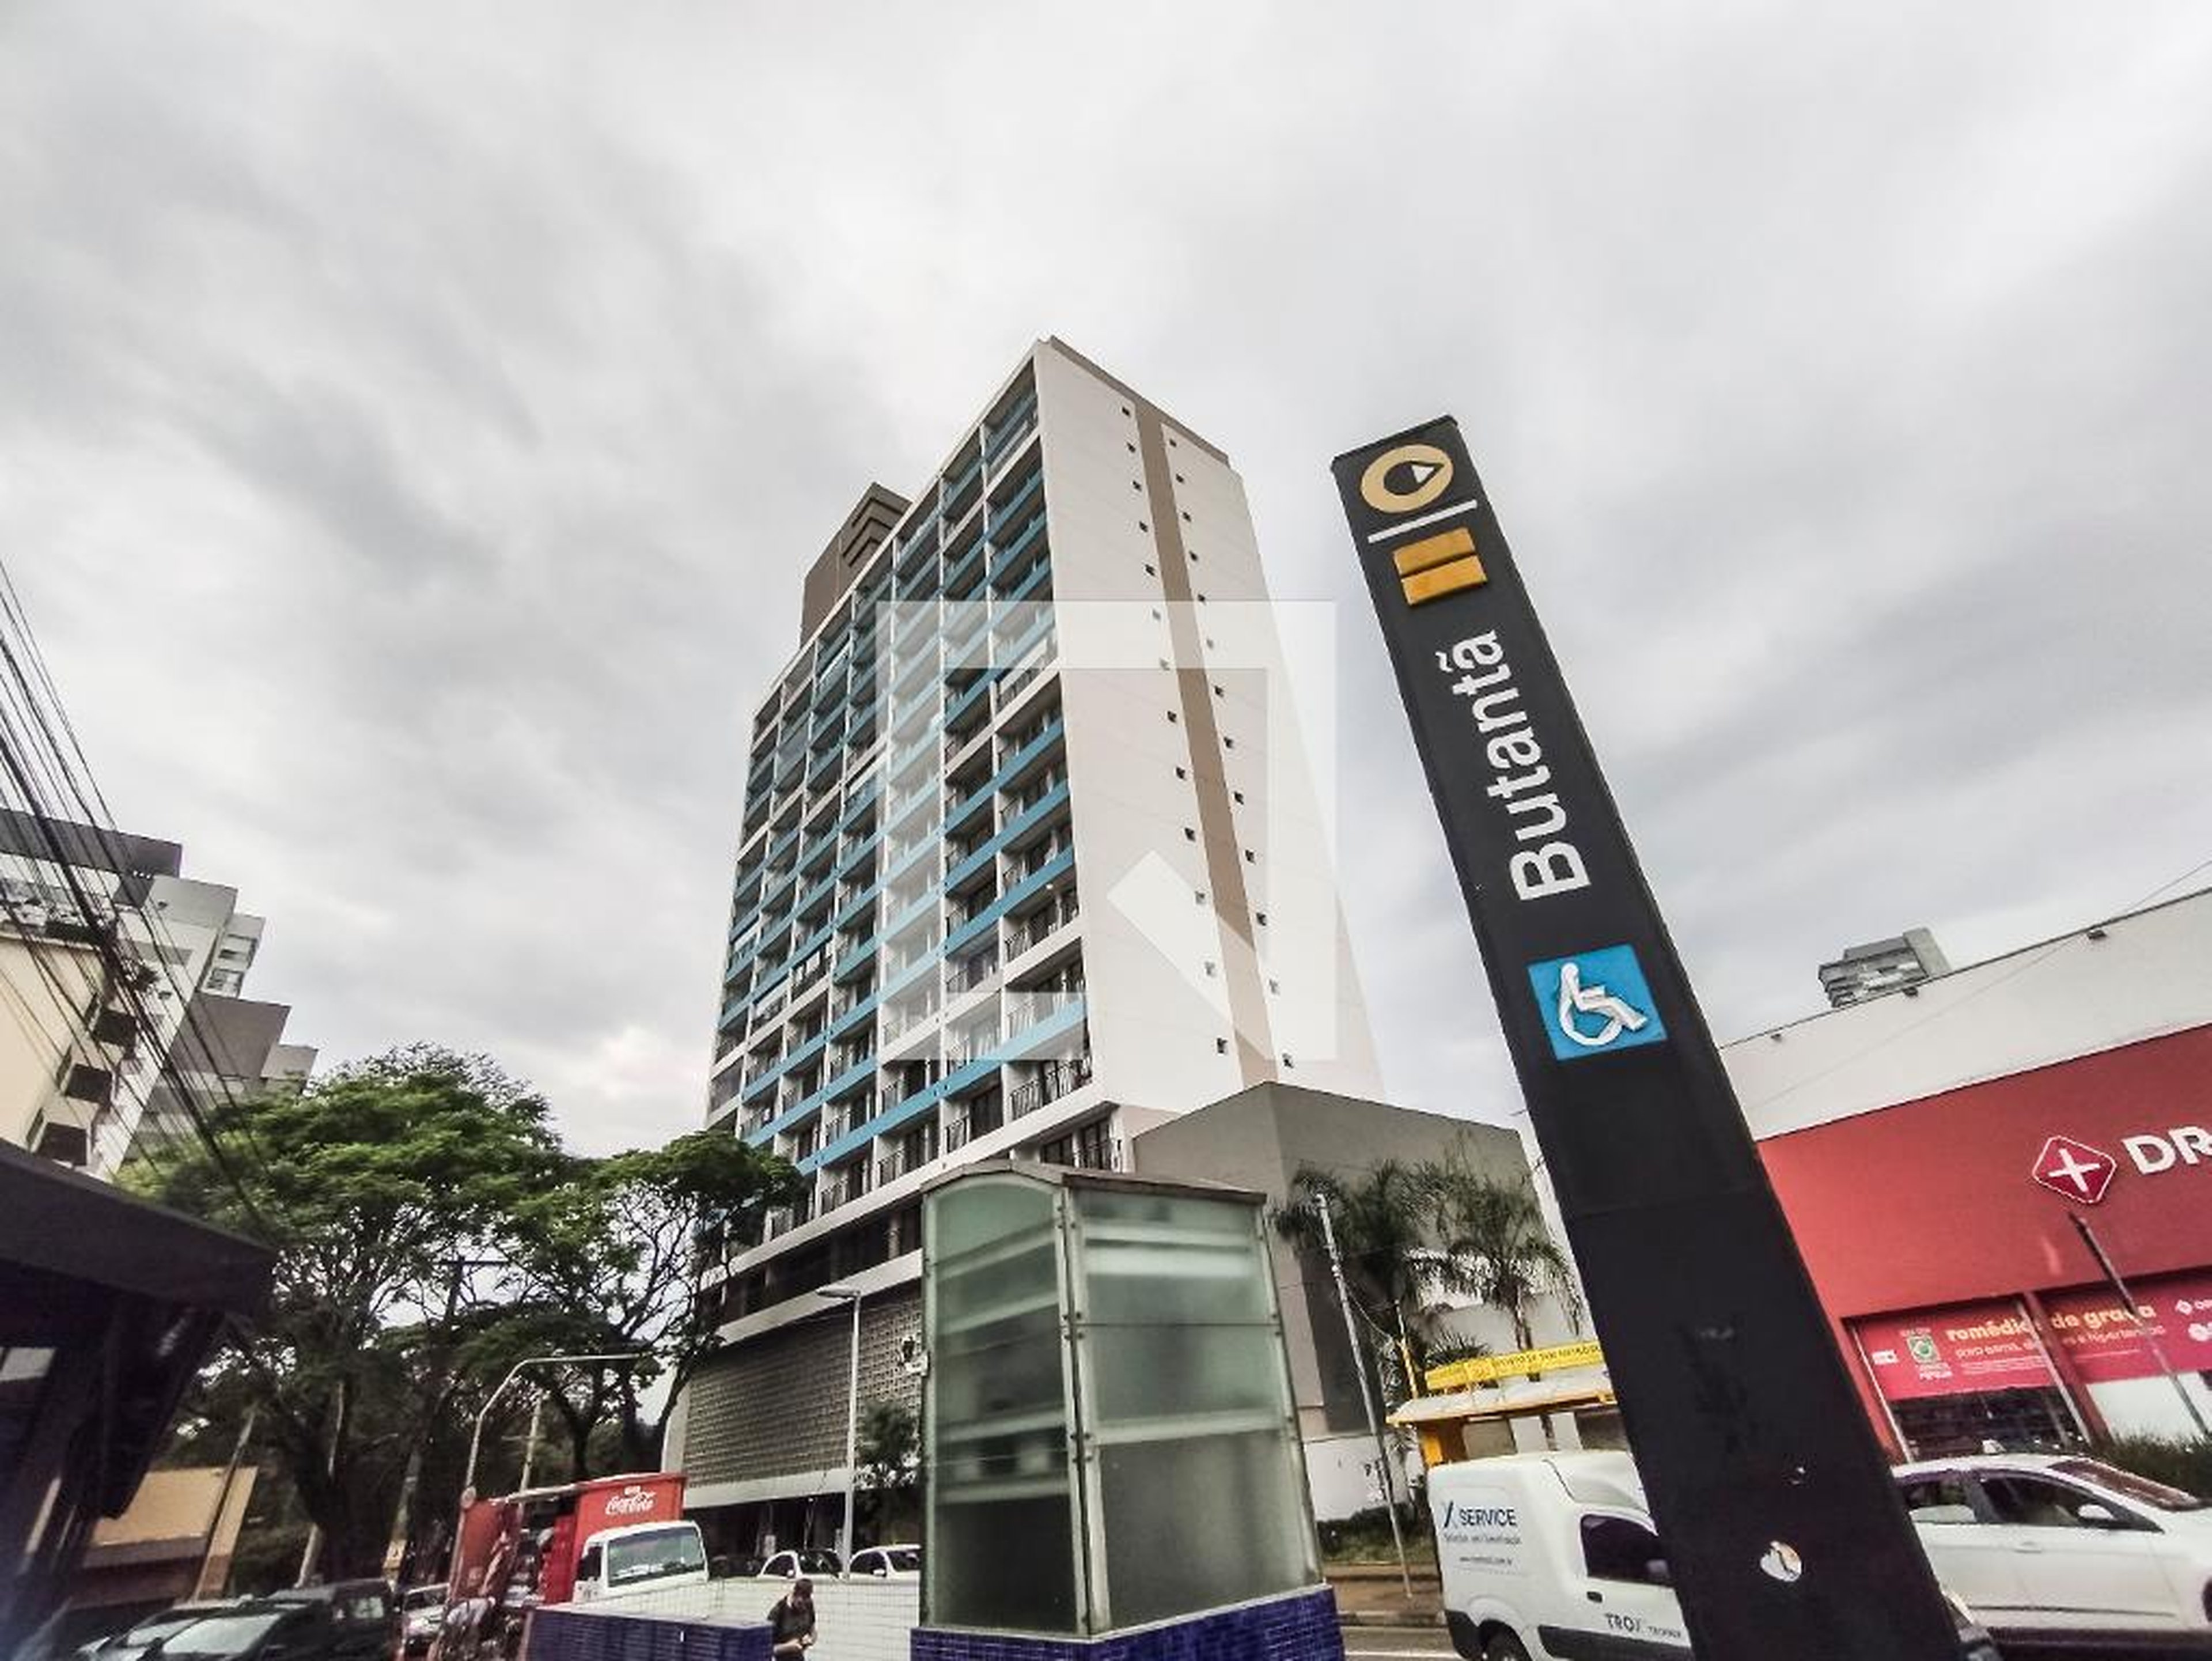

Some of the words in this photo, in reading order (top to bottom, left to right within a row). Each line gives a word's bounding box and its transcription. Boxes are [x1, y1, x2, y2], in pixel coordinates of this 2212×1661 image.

[1435, 630, 1592, 901] Butantã
[2121, 1126, 2212, 1175] DR
[2084, 1306, 2157, 1329] graa
[1459, 1508, 1517, 1526] SERVICE
